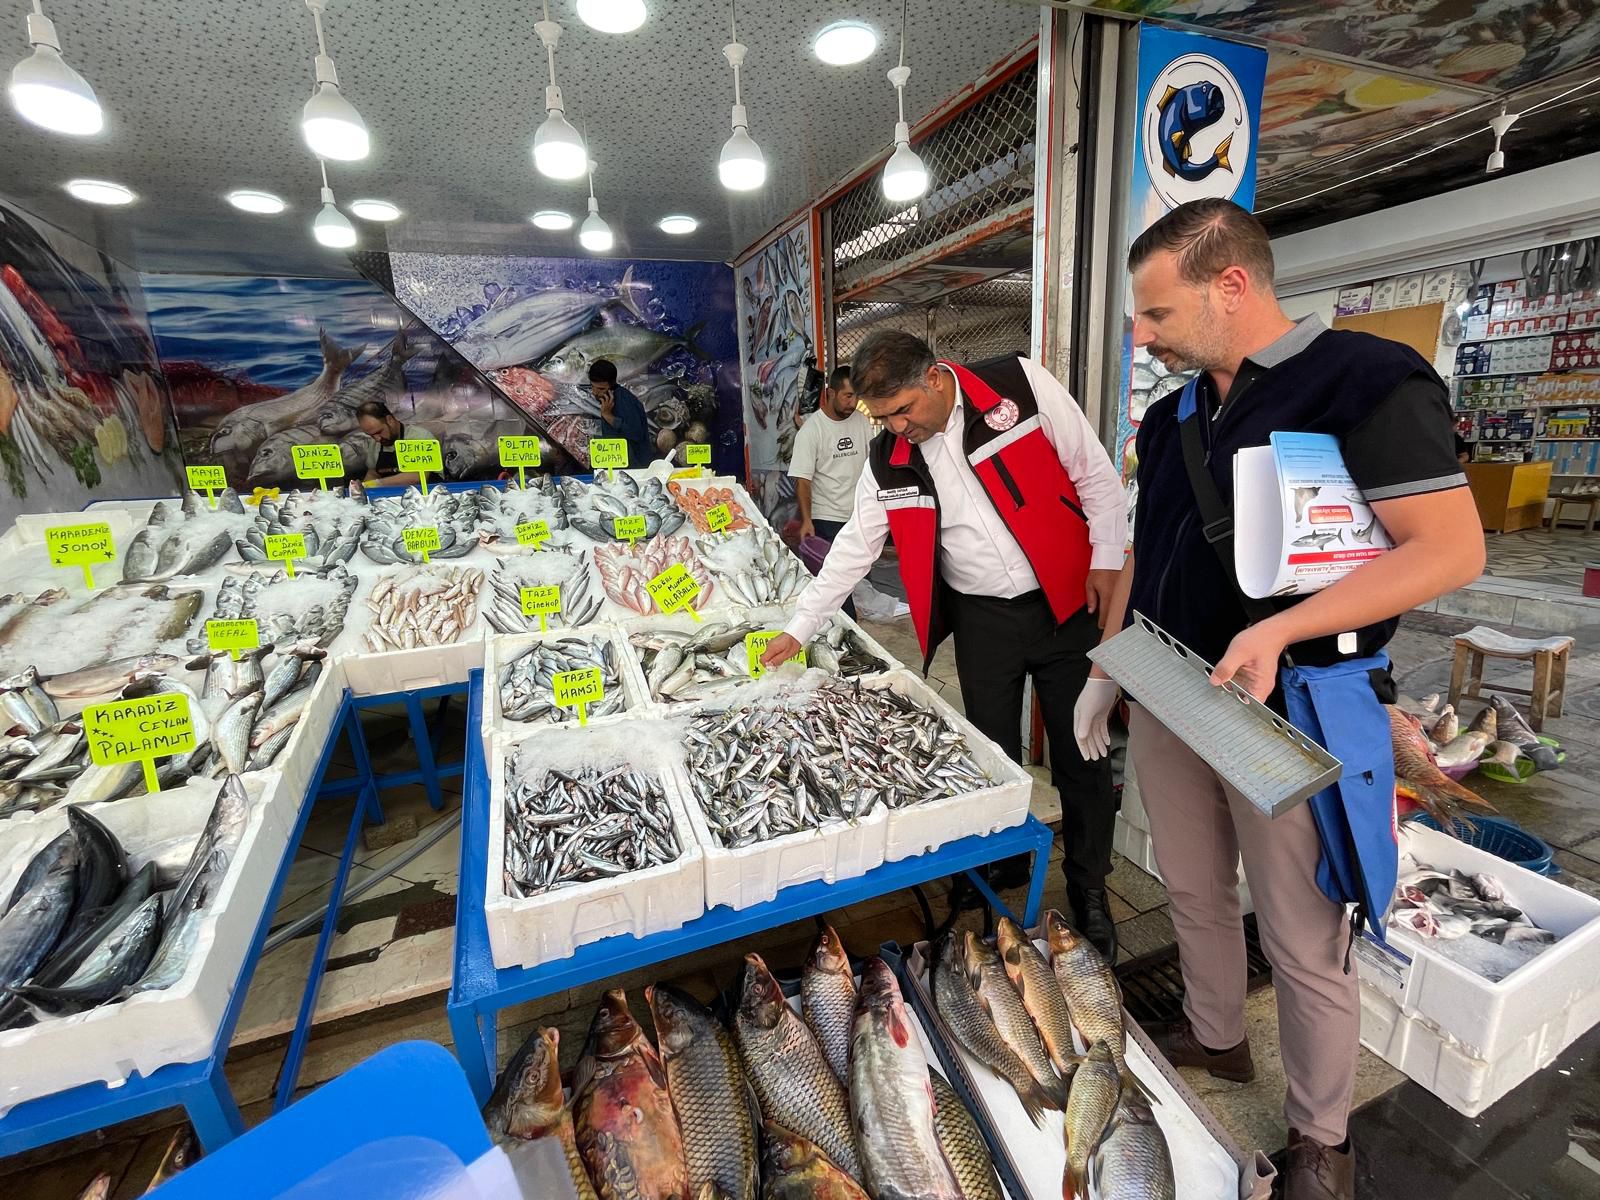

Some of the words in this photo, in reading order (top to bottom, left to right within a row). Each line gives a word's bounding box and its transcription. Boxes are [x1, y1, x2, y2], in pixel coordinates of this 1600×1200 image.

[506, 440, 534, 449] OLTA
[597, 443, 620, 452] OLTA
[57, 539, 107, 554] SOMON
[526, 589, 553, 598] TAZE
[561, 670, 593, 683] TAZE
[139, 717, 188, 732] CEYLAN
[97, 732, 191, 758] PALAMUT
